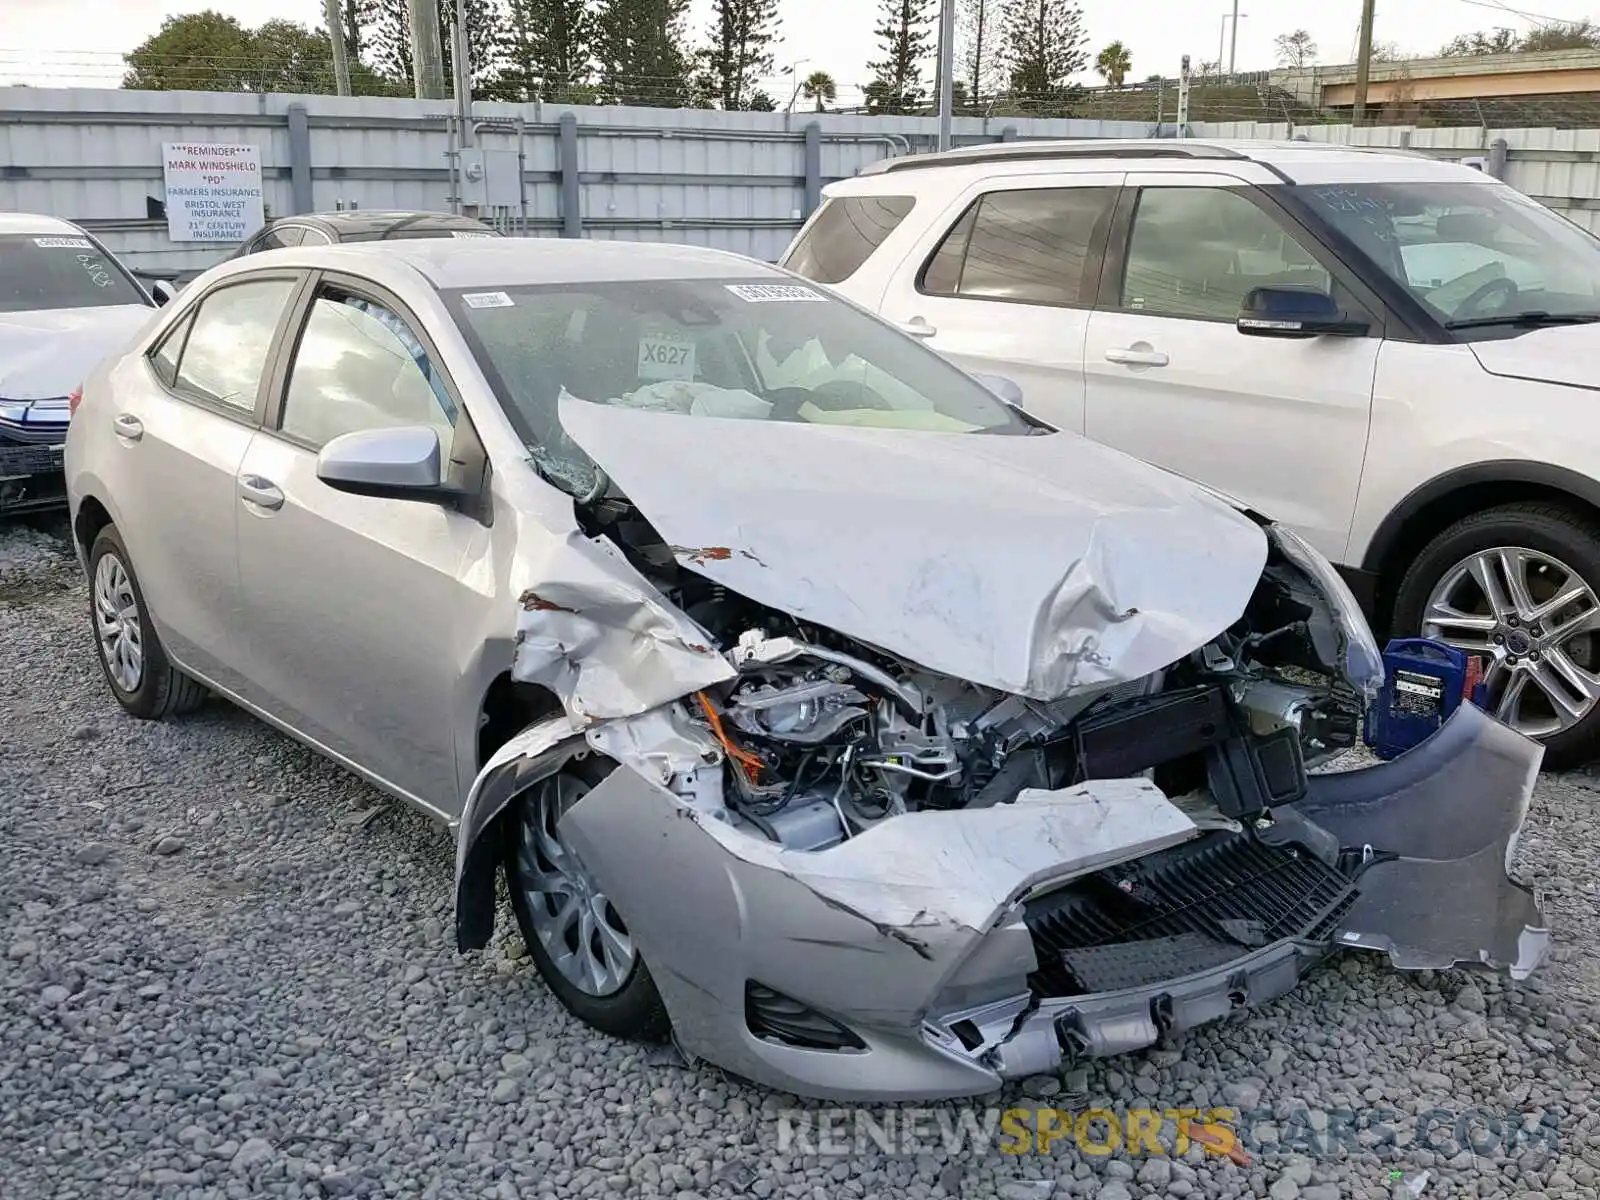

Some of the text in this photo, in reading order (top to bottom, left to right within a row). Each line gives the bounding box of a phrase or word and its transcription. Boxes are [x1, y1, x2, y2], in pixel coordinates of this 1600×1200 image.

[168, 160, 256, 171] MARK WINDSHIELD
[168, 188, 261, 197] FARMERS INSURANCE
[185, 200, 246, 209] BRISTOL WEST
[191, 209, 241, 218] INSURANCE
[207, 222, 247, 231] CENTURY
[193, 231, 243, 239] INSURANCE
[643, 343, 691, 365] X627
